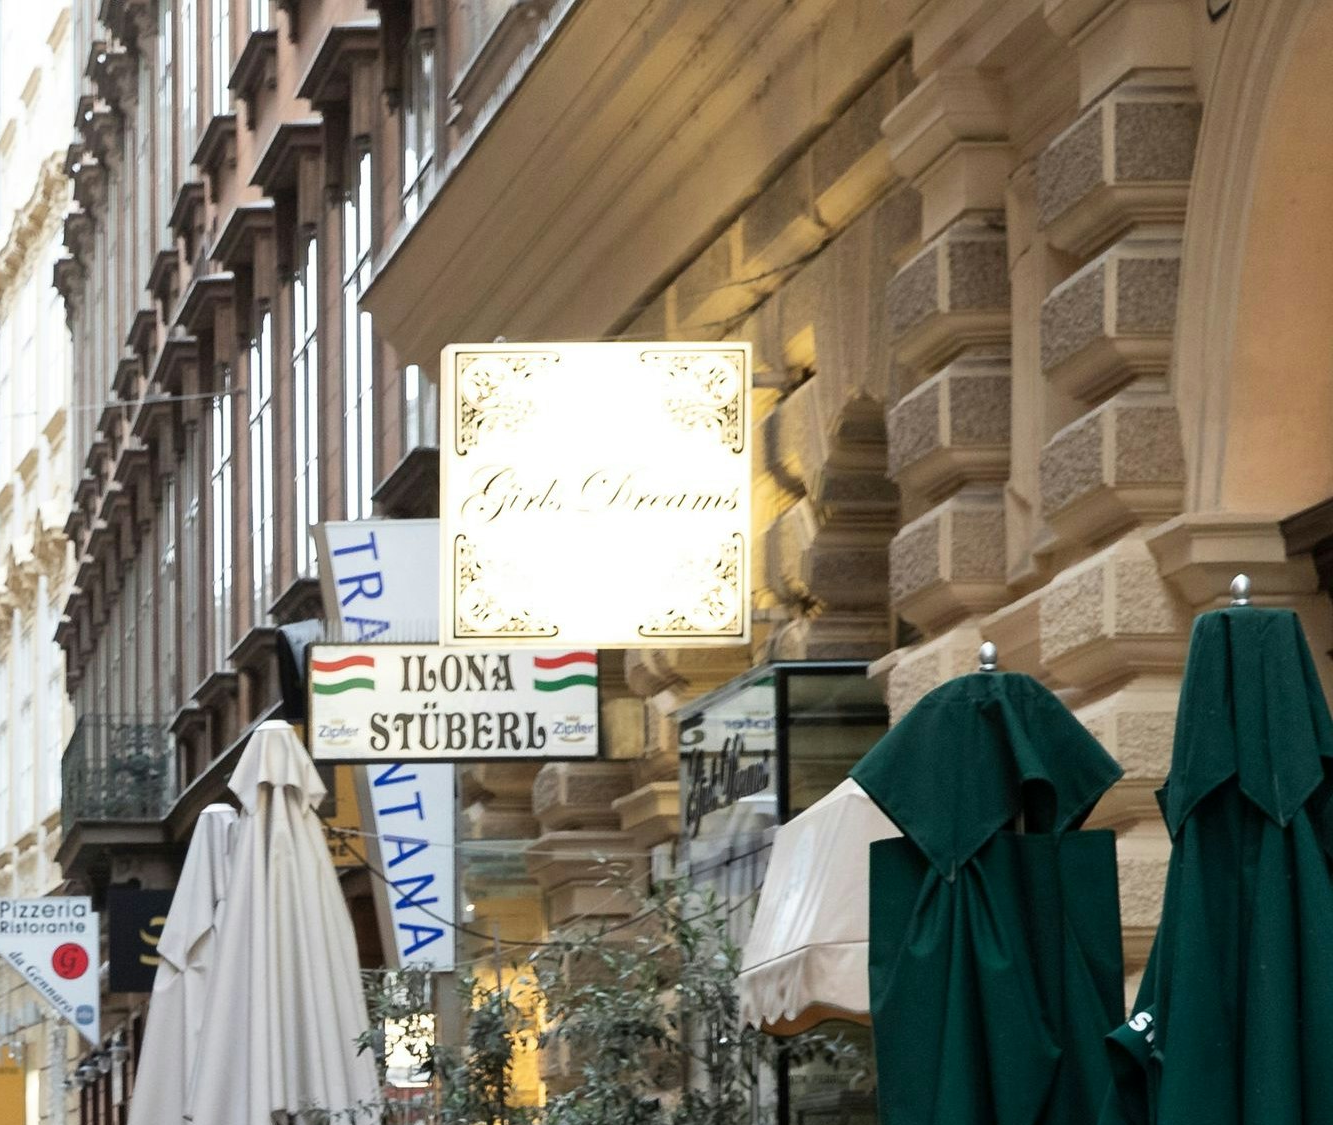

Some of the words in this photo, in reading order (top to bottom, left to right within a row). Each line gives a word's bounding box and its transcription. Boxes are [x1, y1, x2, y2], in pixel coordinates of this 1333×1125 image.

[400, 654, 516, 693] ILONA
[369, 702, 547, 751] STÜBERL
[0, 900, 86, 918] Pizzeria
[0, 920, 86, 934] Ristorante
[8, 950, 25, 966] da
